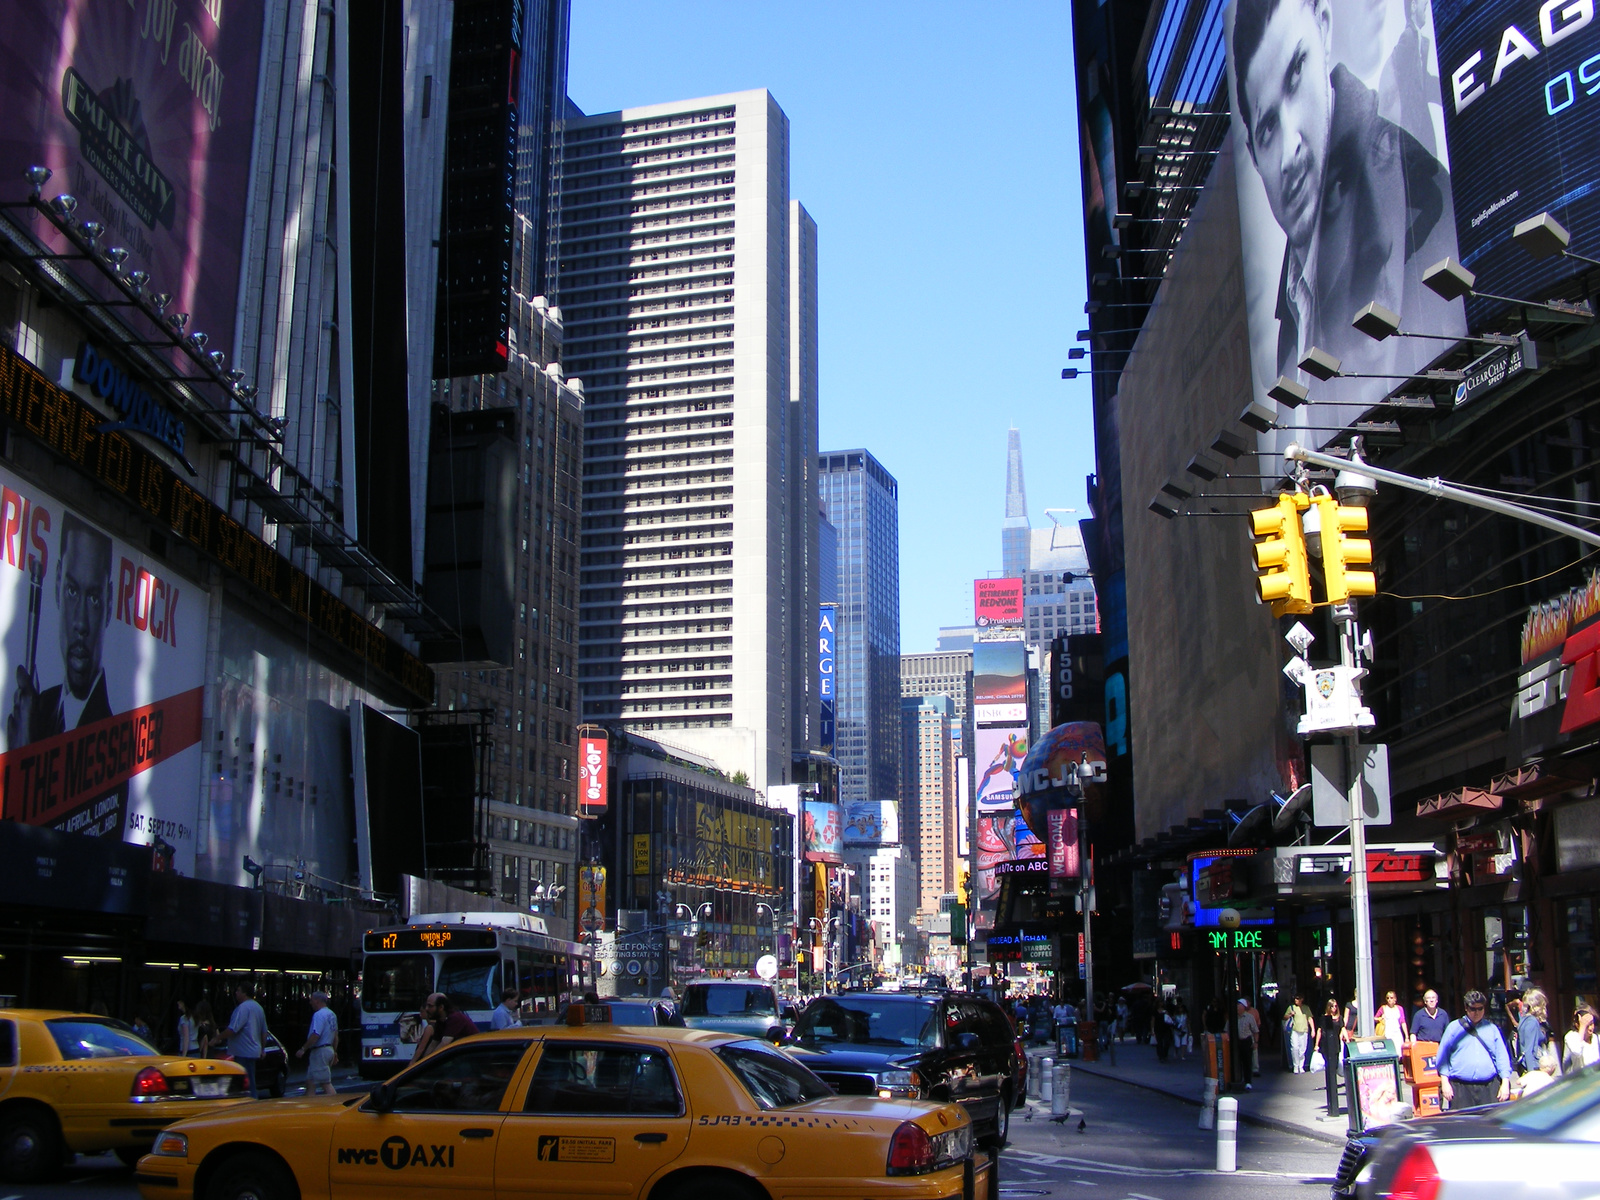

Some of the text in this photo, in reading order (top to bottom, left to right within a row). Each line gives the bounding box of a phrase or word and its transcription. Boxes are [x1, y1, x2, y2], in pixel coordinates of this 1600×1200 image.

[1451, 0, 1595, 115] EAG
[67, 73, 174, 214] EMPIRE CITY
[106, 145, 136, 186] GAMING
[85, 144, 153, 225] YONKERS RACEWAY
[1471, 190, 1519, 228] EagleEyeMovie.com
[499, 112, 516, 339] DISTINCT BY DESIGN
[138, 453, 164, 516] US
[170, 479, 212, 551] OPEN
[116, 556, 180, 648] ROCK
[979, 589, 1019, 598] RETIREMENT
[989, 616, 1022, 624] Prudential
[819, 614, 834, 735] ARGENT
[1060, 638, 1073, 699] 1500
[978, 709, 1002, 718] HSBC
[20, 747, 60, 822] THE
[64, 709, 164, 802] MESSENGER
[1052, 760, 1107, 788] JC
[986, 793, 1014, 801] SAMSUN
[66, 808, 92, 833] AFRICA,
[94, 793, 119, 819] LONDON,
[129, 812, 145, 834] SAT,
[147, 817, 164, 837] SEPT
[165, 820, 177, 841] 27,
[635, 849, 648, 858] LION
[1051, 814, 1065, 875] WELCOME
[635, 859, 648, 868] KING
[1027, 861, 1049, 871] ABC
[383, 933, 398, 949] M7
[421, 932, 440, 941] UNION
[427, 940, 435, 948] 14
[1209, 930, 1263, 948] AMRAS
[698, 1115, 741, 1126] 5J93
[338, 1140, 455, 1168] NYC TAXI
